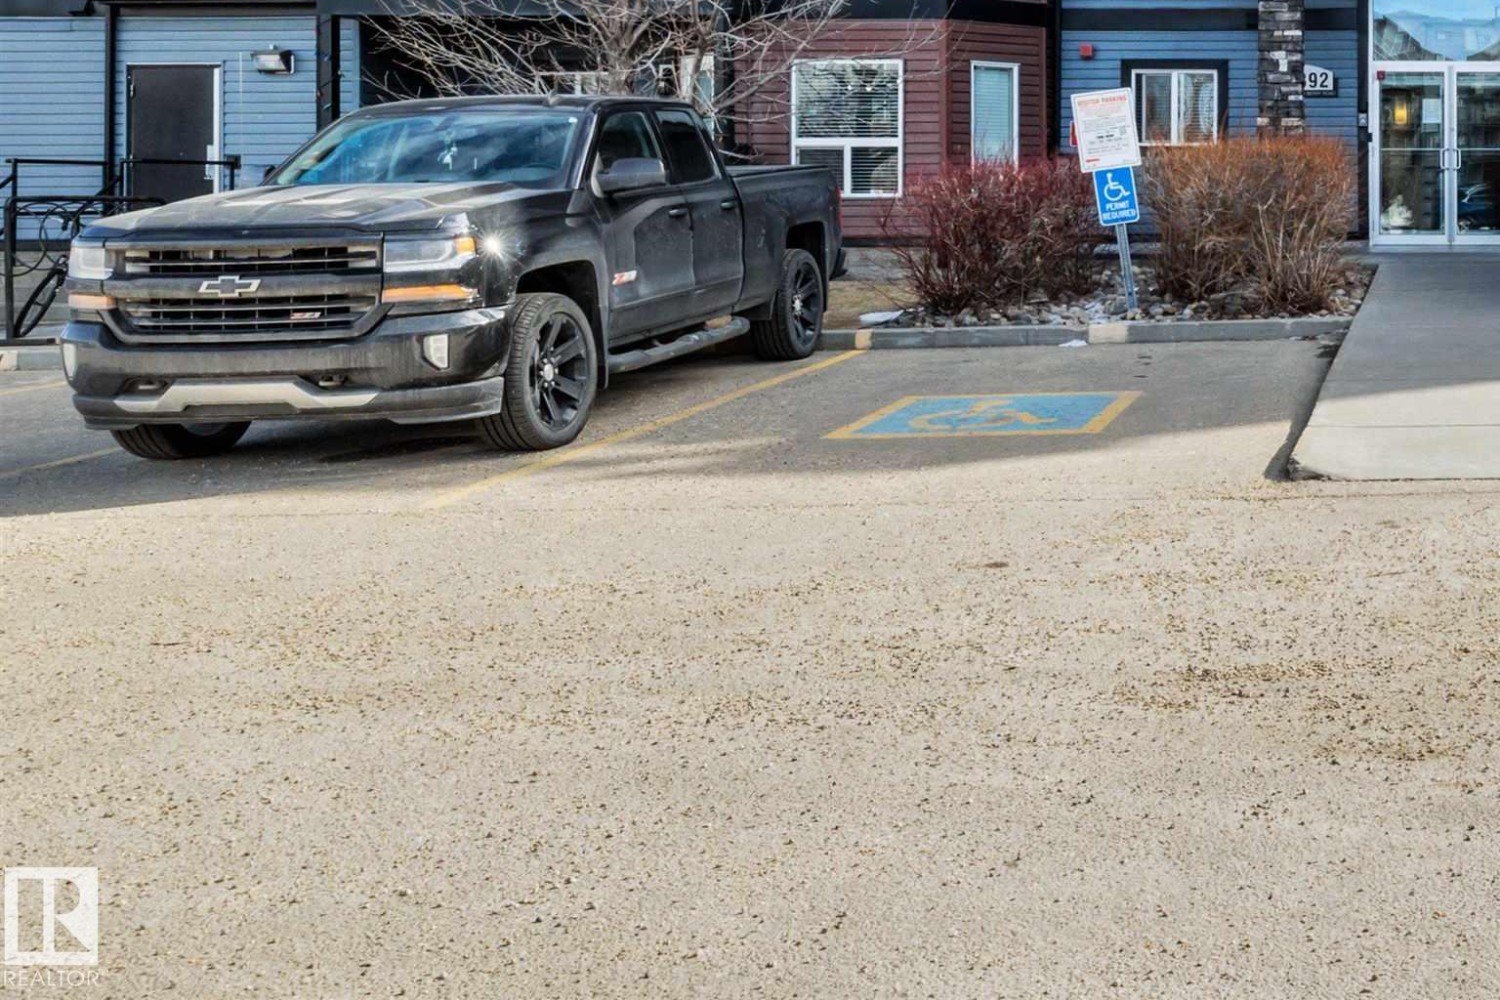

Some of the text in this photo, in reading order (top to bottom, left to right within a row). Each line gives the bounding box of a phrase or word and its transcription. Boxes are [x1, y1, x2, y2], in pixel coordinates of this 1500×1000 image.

[1304, 72, 1329, 88] 92
[1105, 200, 1129, 211] PERMIT
[1102, 208, 1136, 220] REQUIRED
